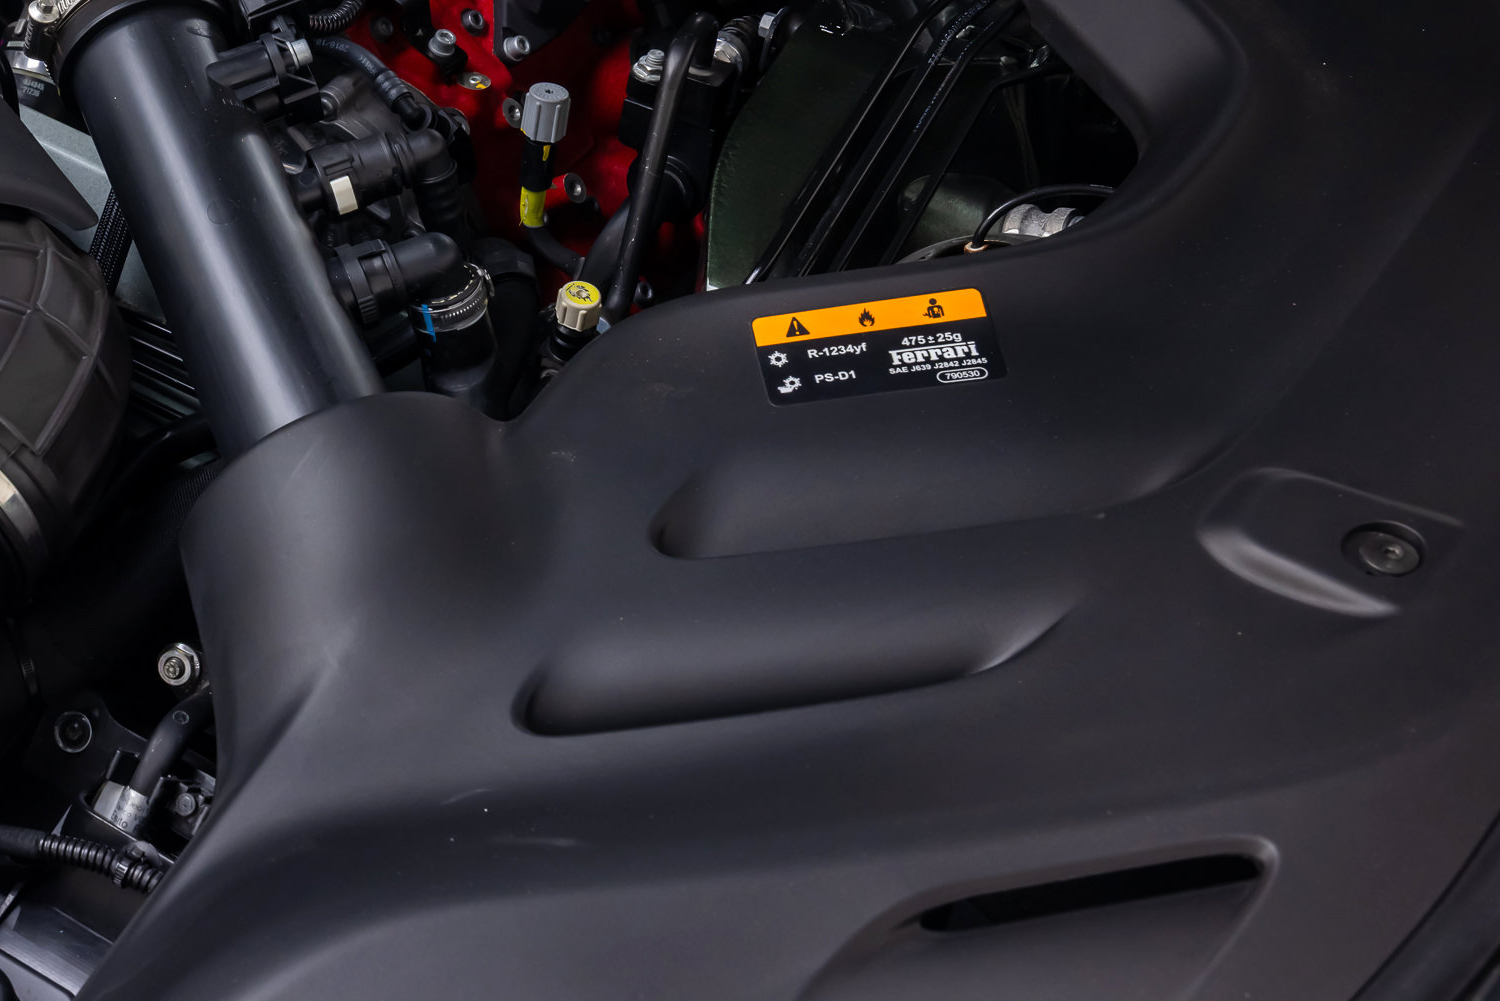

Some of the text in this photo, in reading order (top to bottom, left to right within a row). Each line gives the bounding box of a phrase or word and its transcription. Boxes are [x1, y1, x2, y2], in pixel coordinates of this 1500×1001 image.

[807, 342, 867, 359] R-1234yf
[888, 341, 980, 366] Ferrari
[888, 357, 988, 375] SAE J639 J2842 J2845
[944, 369, 980, 380] 790530
[814, 370, 857, 384] PS-D1
